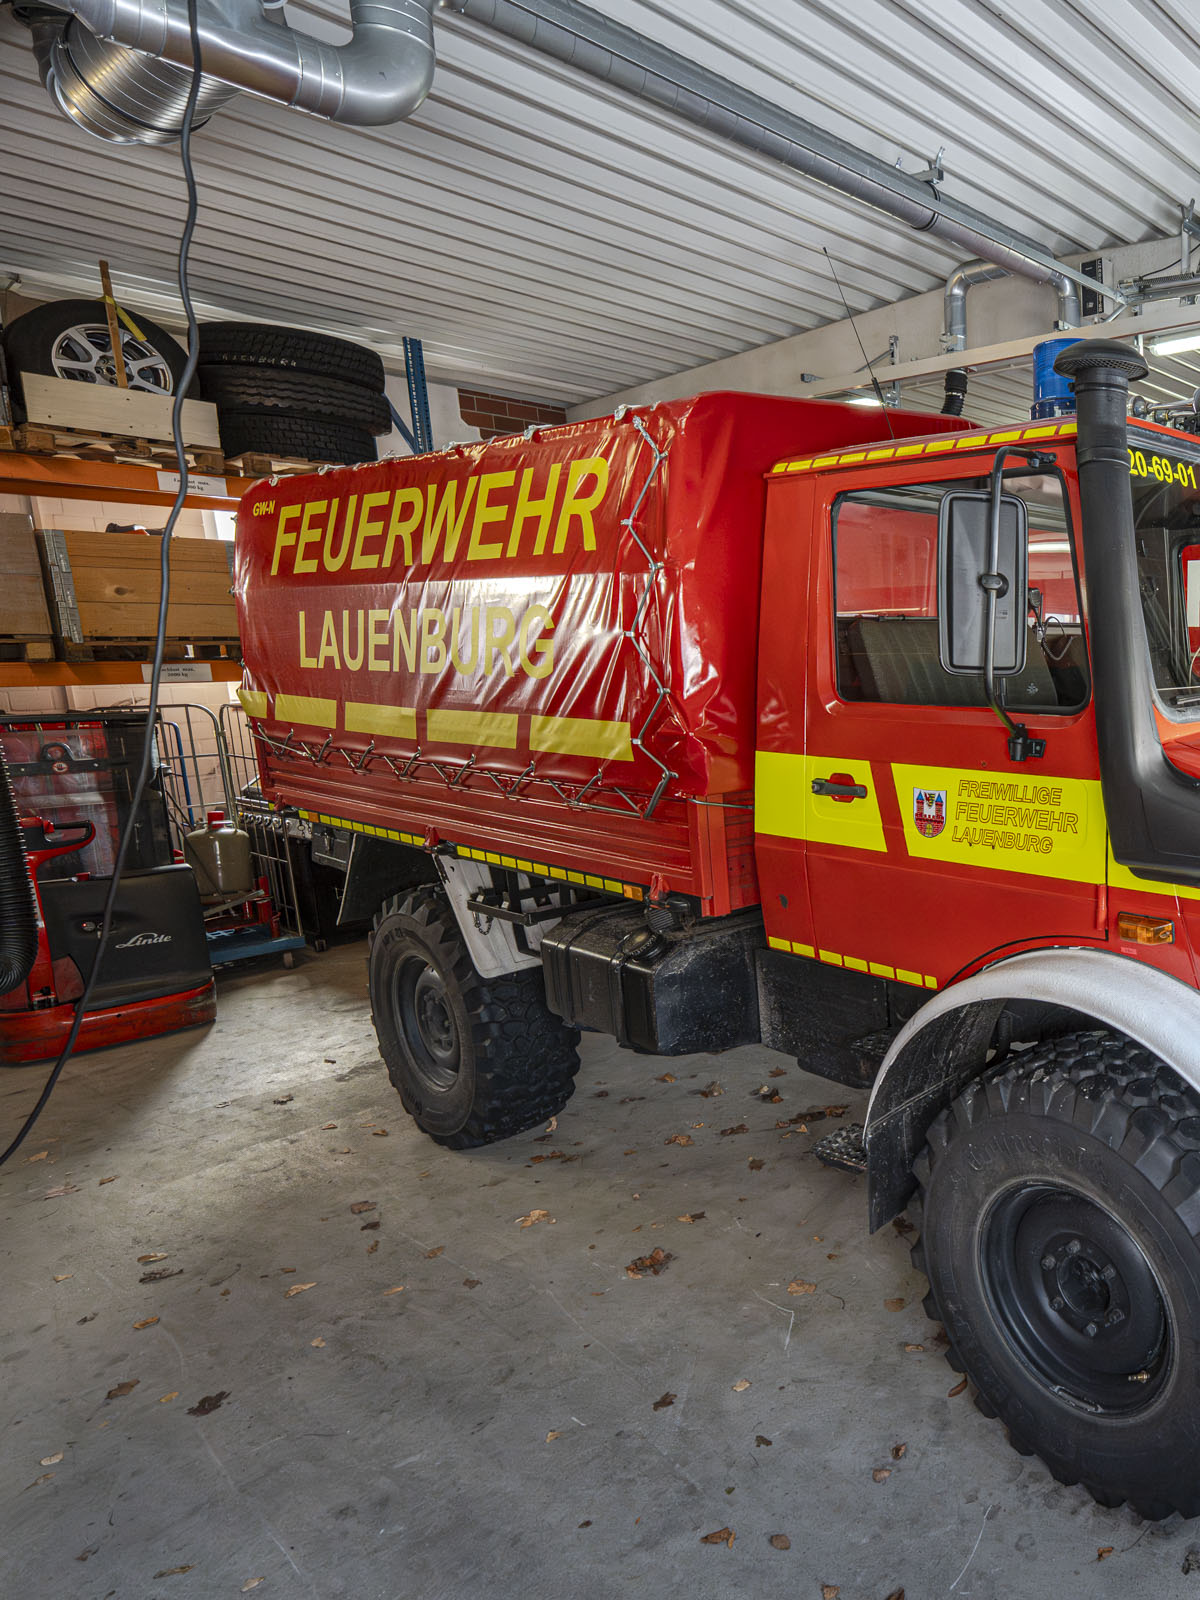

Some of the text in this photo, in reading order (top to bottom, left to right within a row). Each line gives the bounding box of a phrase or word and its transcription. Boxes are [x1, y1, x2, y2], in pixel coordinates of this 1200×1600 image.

[252, 500, 276, 517] GW-N
[271, 456, 609, 576] FEUERWEHR
[299, 604, 555, 680] LAUENBURG
[957, 779, 1063, 807] FREIWILLIGE
[955, 801, 1079, 835] FEUERWEHR
[951, 825, 1054, 854] LAUENBURG
[114, 932, 172, 949] Linde
